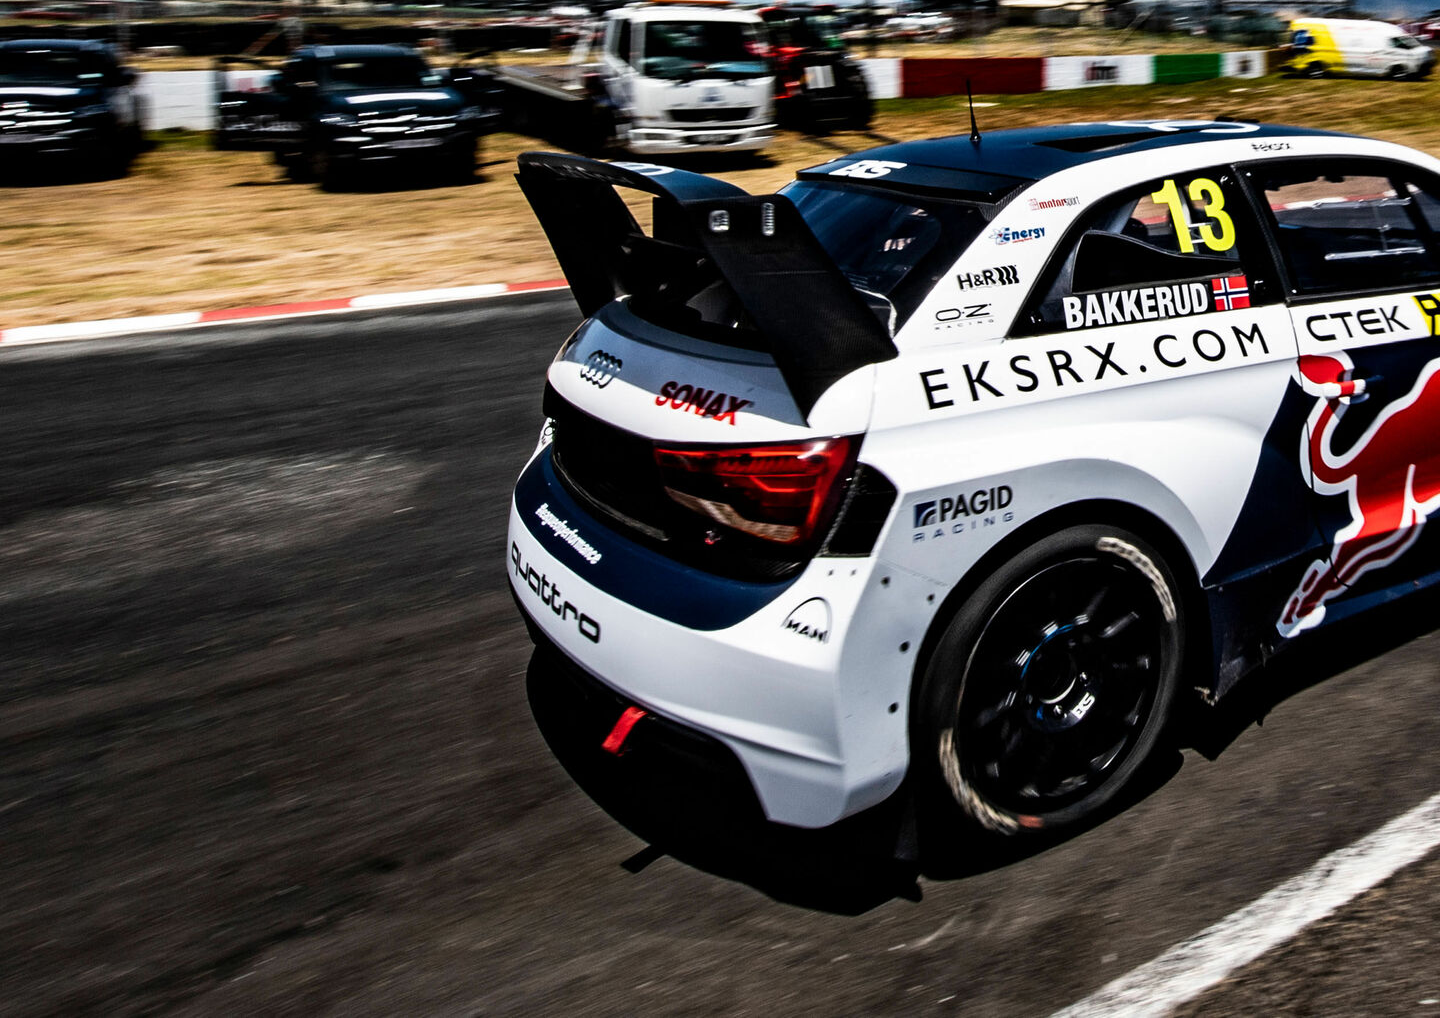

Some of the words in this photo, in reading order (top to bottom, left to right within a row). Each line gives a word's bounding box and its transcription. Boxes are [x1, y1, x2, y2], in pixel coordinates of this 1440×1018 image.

[1151, 178, 1236, 254] 13
[956, 271, 997, 291] H&R
[1063, 283, 1208, 329] BAKKERUD
[1306, 305, 1410, 342] CTEK
[919, 323, 1270, 410] EKSRX.COM
[655, 381, 750, 425] SONAX
[939, 485, 1013, 523] PAGID
[912, 512, 1015, 544] RACING
[511, 541, 602, 644] quattro
